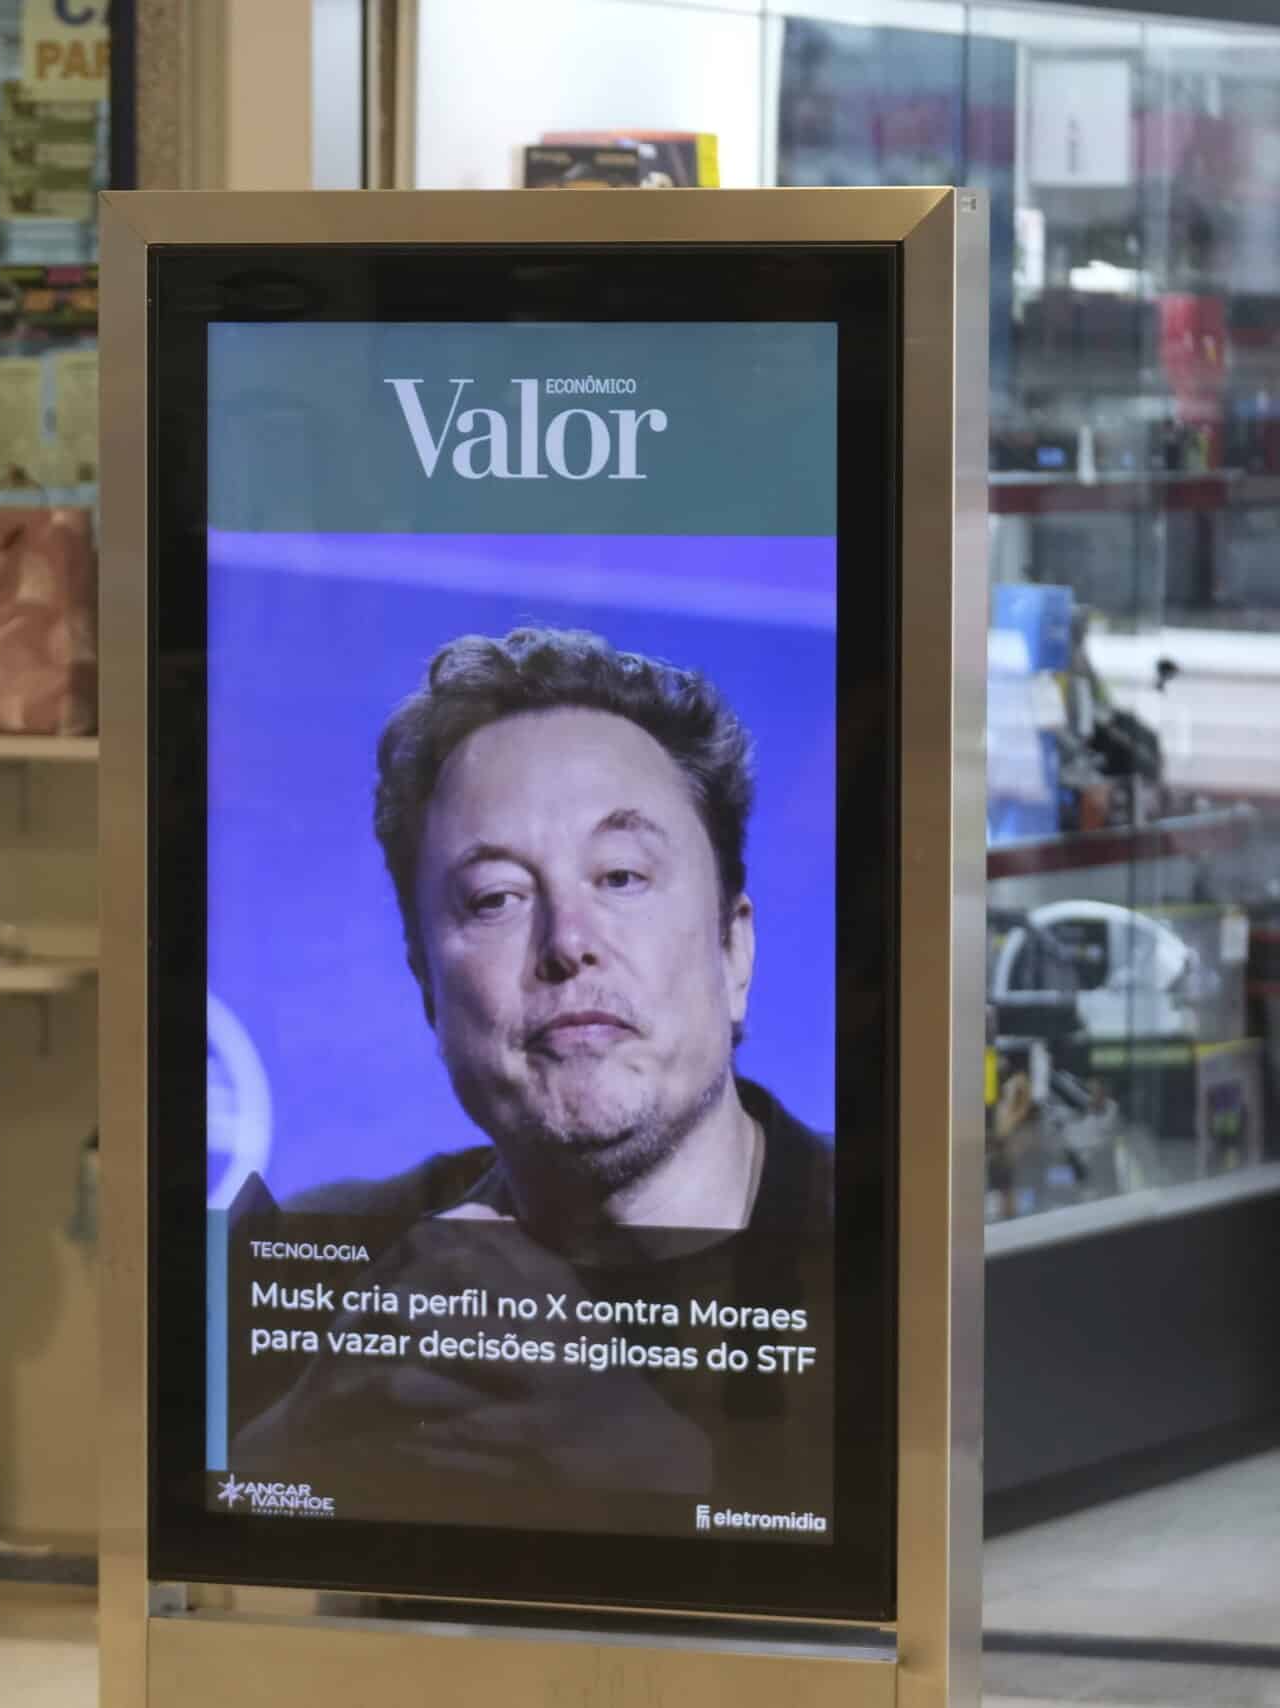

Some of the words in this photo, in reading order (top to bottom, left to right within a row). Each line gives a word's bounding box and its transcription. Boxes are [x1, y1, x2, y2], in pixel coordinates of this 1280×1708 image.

[545, 376, 636, 394] ECONÔMICO
[383, 378, 668, 480] Valor
[250, 1240, 370, 1262] TECNOLOGIA
[251, 1281, 335, 1312] Musk
[342, 1284, 399, 1314] cria
[408, 1289, 488, 1320] perfil
[497, 1296, 538, 1320] no
[545, 1293, 567, 1321] X
[575, 1298, 680, 1326] contra
[690, 1299, 808, 1331] Moraes
[251, 1327, 319, 1354] para
[327, 1331, 410, 1355] vazar
[419, 1329, 556, 1362] decisões
[563, 1335, 699, 1371] sigilosas
[706, 1341, 749, 1371] do
[756, 1345, 817, 1374] STF
[244, 1481, 312, 1497] ANCAR
[251, 1493, 336, 1511] IVANHOE
[713, 1507, 827, 1531] eletromidia
